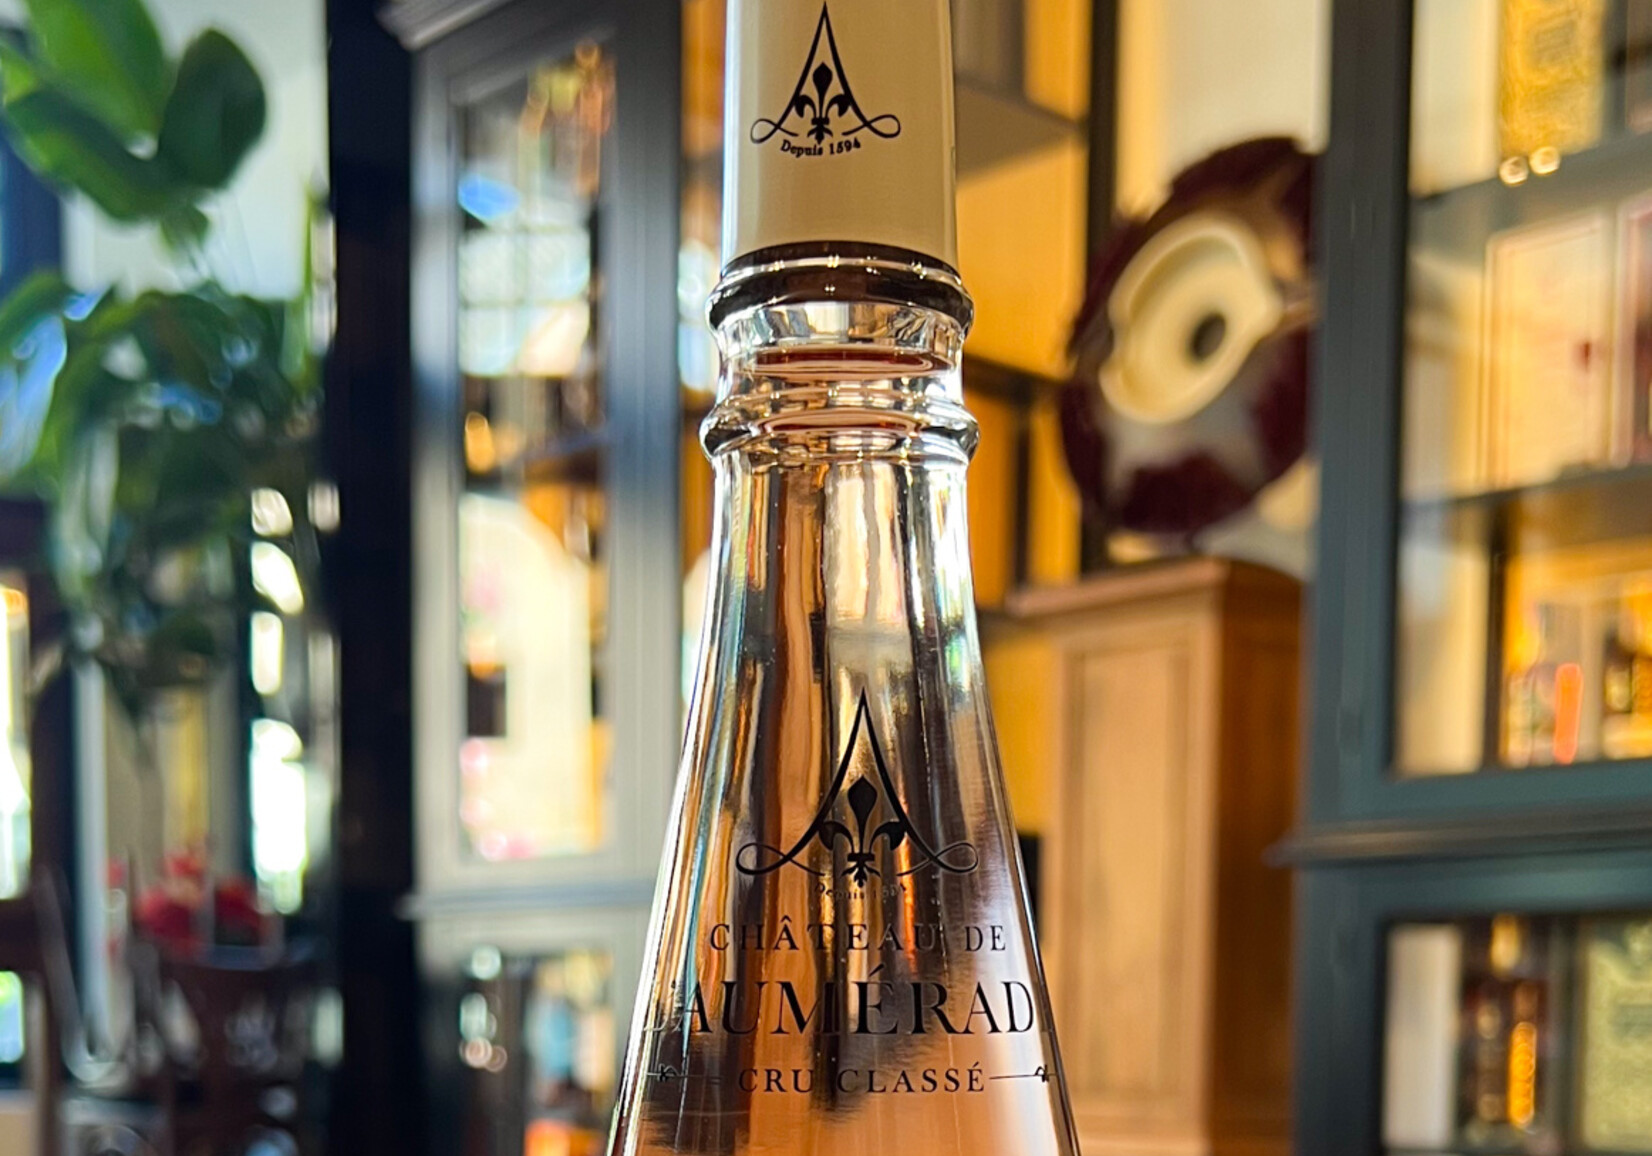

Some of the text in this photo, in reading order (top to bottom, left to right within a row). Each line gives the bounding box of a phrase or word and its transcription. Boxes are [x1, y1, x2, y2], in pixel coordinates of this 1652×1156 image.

[781, 137, 861, 158] Depuis 1594
[710, 914, 1006, 952] CHÂTEAU DE
[738, 1061, 985, 1093] CRU CLASSÉ
